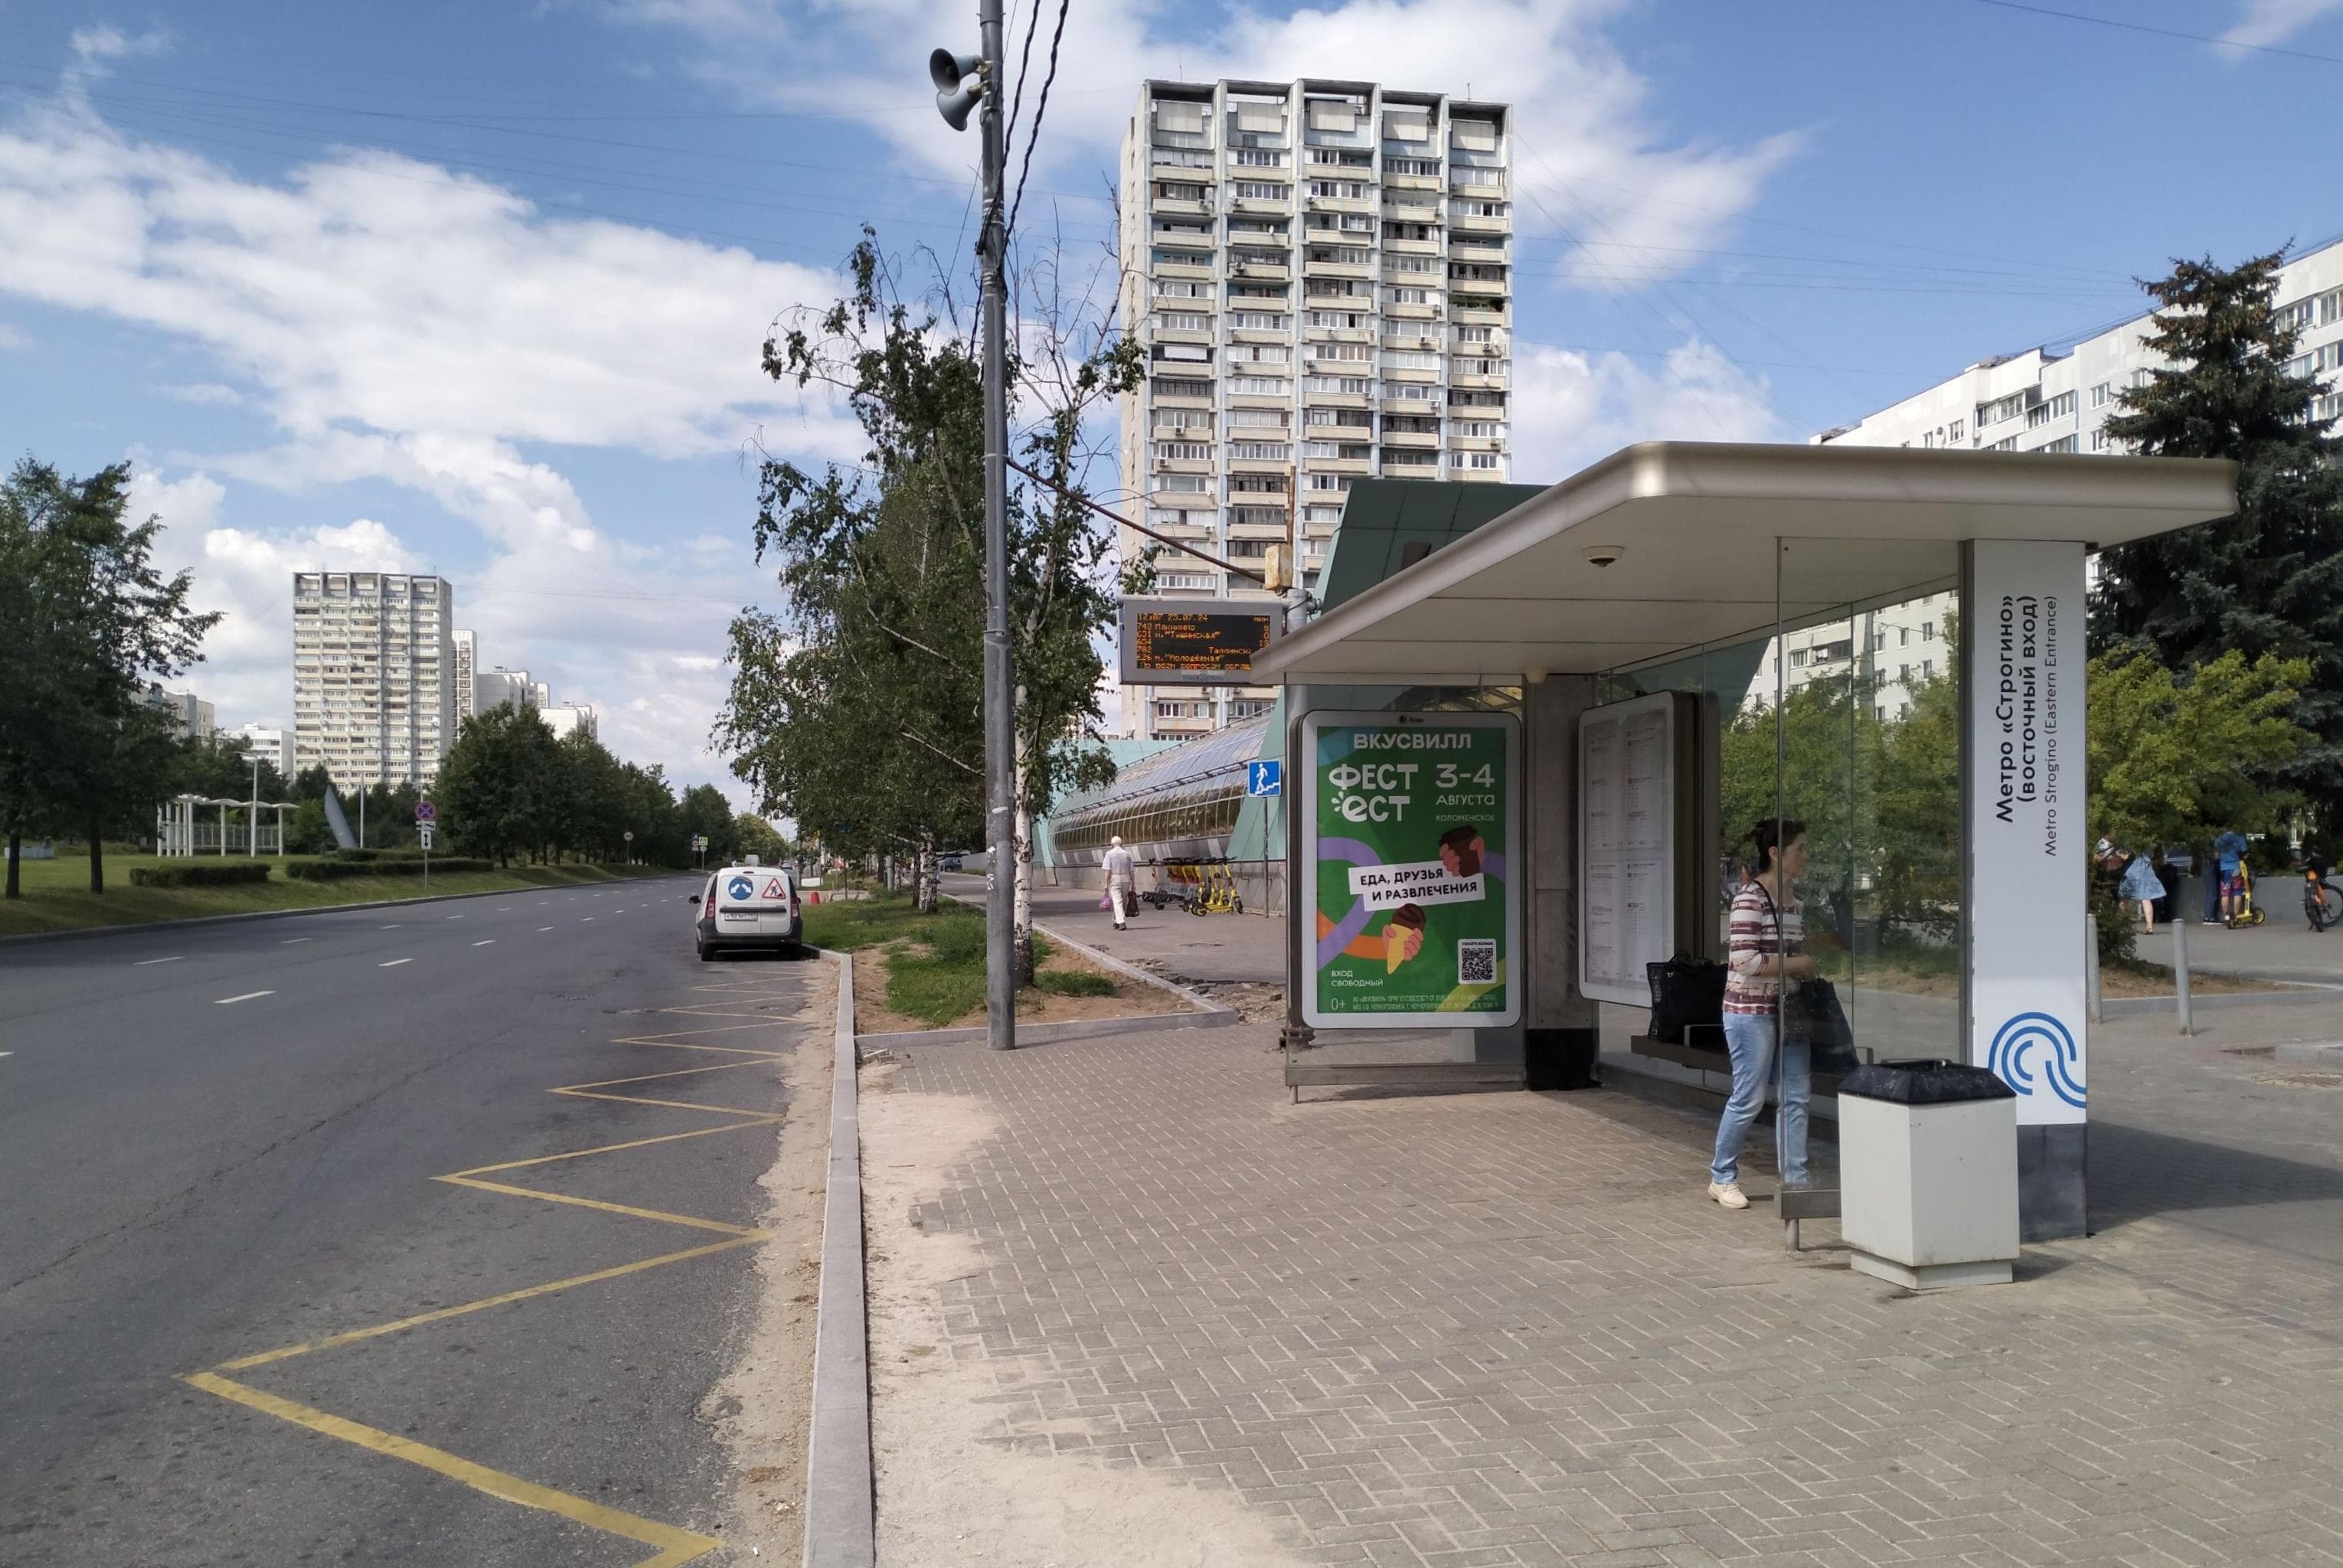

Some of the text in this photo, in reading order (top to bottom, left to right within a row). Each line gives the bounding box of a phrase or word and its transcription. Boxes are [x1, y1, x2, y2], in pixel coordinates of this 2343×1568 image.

[1996, 596, 2017, 823] Метро «Строгино»
[2016, 596, 2037, 802] (восточный вход)
[2044, 596, 2059, 856] Metro Strogino (Eastern Entrance)
[1354, 733, 1472, 749] ВКУСВИЛЛ
[1328, 763, 1419, 790] ФЕСТ
[1436, 764, 1495, 788] 3-4
[1360, 868, 1443, 886] ЕДА, ДРУЗЬЯ
[1372, 881, 1477, 901] И РАЗВЛЕЧЕНИЯ
[1331, 978, 1384, 987] СВОБОДНЫЙ
[1331, 998, 1346, 1011] 0+
